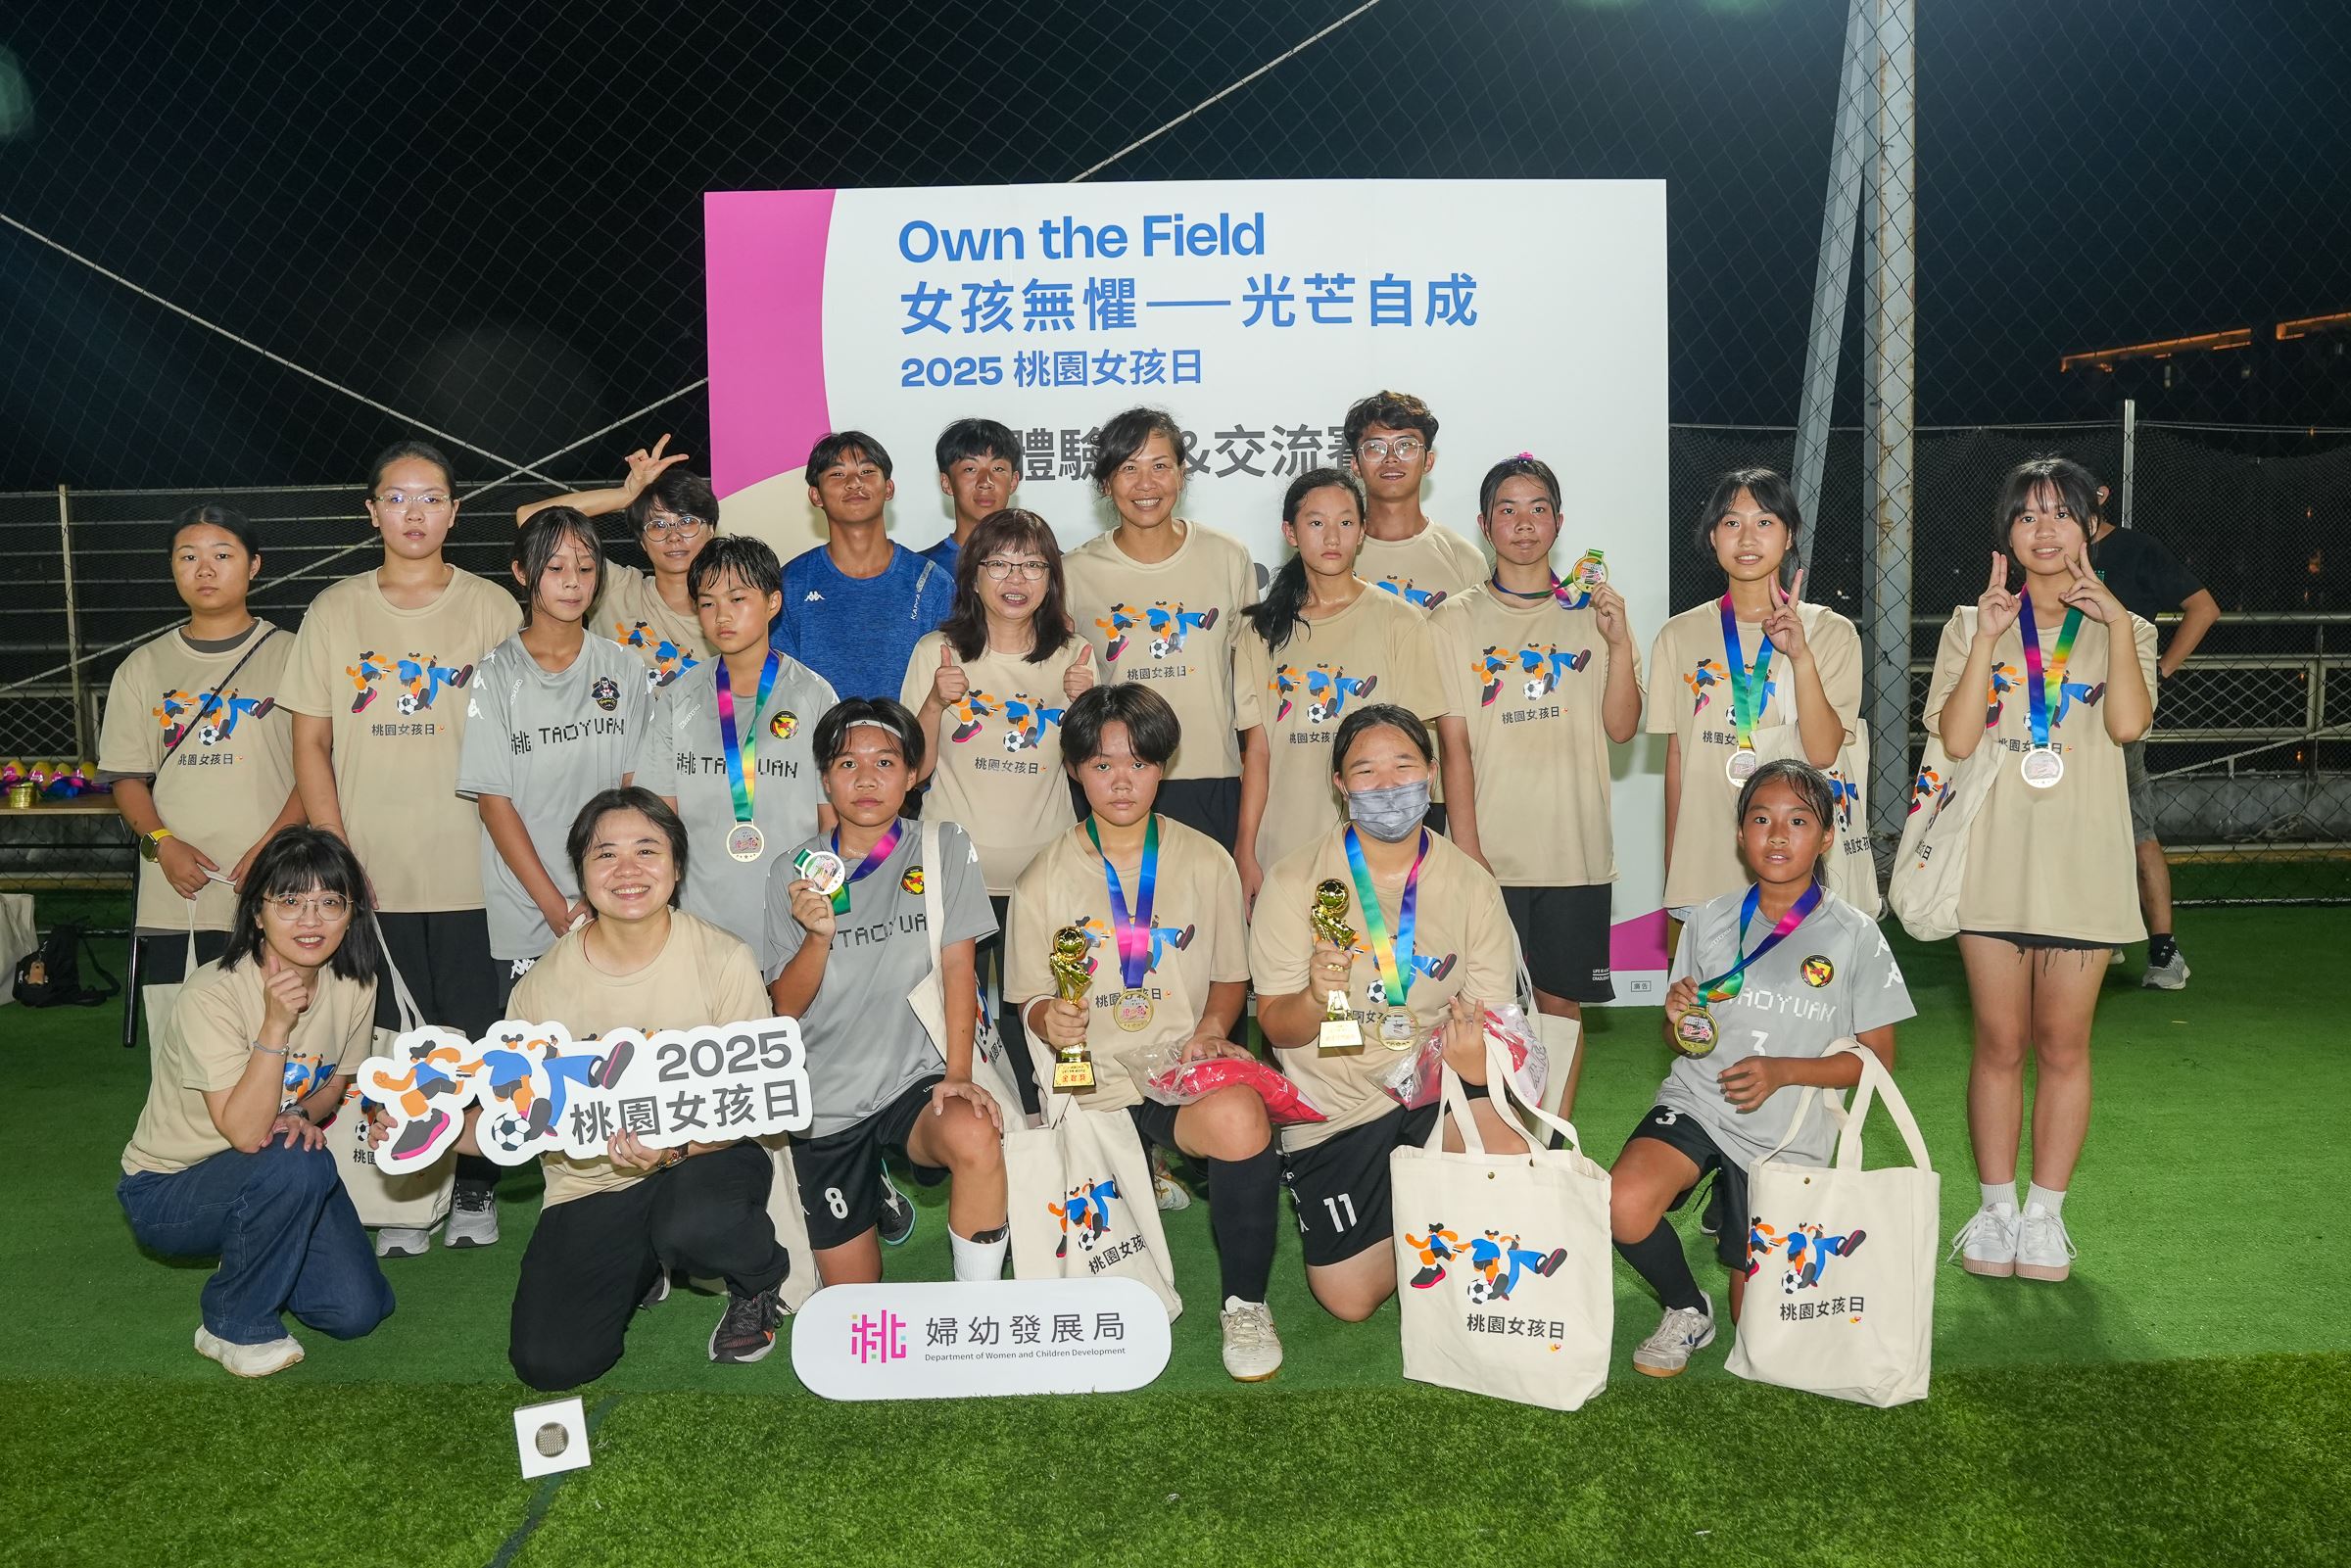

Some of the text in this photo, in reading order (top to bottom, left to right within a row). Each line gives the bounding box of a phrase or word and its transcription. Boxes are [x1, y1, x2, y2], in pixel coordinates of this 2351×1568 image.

[898, 213, 1265, 262] Own the Field
[901, 348, 1201, 388] 2025 桃園女孩日
[371, 724, 435, 736] 桃園女孩日
[1502, 706, 1559, 725] 桃園女孩日
[538, 718, 624, 744] TAOYUAN
[701, 757, 798, 779] TAUAN
[975, 757, 1038, 775] 桃園女孩日
[1730, 987, 1837, 1022] AOYUAN
[656, 1030, 792, 1082] 2025
[570, 1079, 799, 1145] 桃園女孩日
[824, 1187, 848, 1219] 8
[1322, 1193, 1357, 1232] 11
[1780, 1297, 1864, 1321] 桃園女孩日
[926, 1312, 1125, 1347] 婦幼發展局
[1466, 1313, 1564, 1340] 桃園女孩日
[925, 1353, 974, 1362] Department
[1035, 1349, 1071, 1357] Children
[1072, 1348, 1126, 1357] Development
